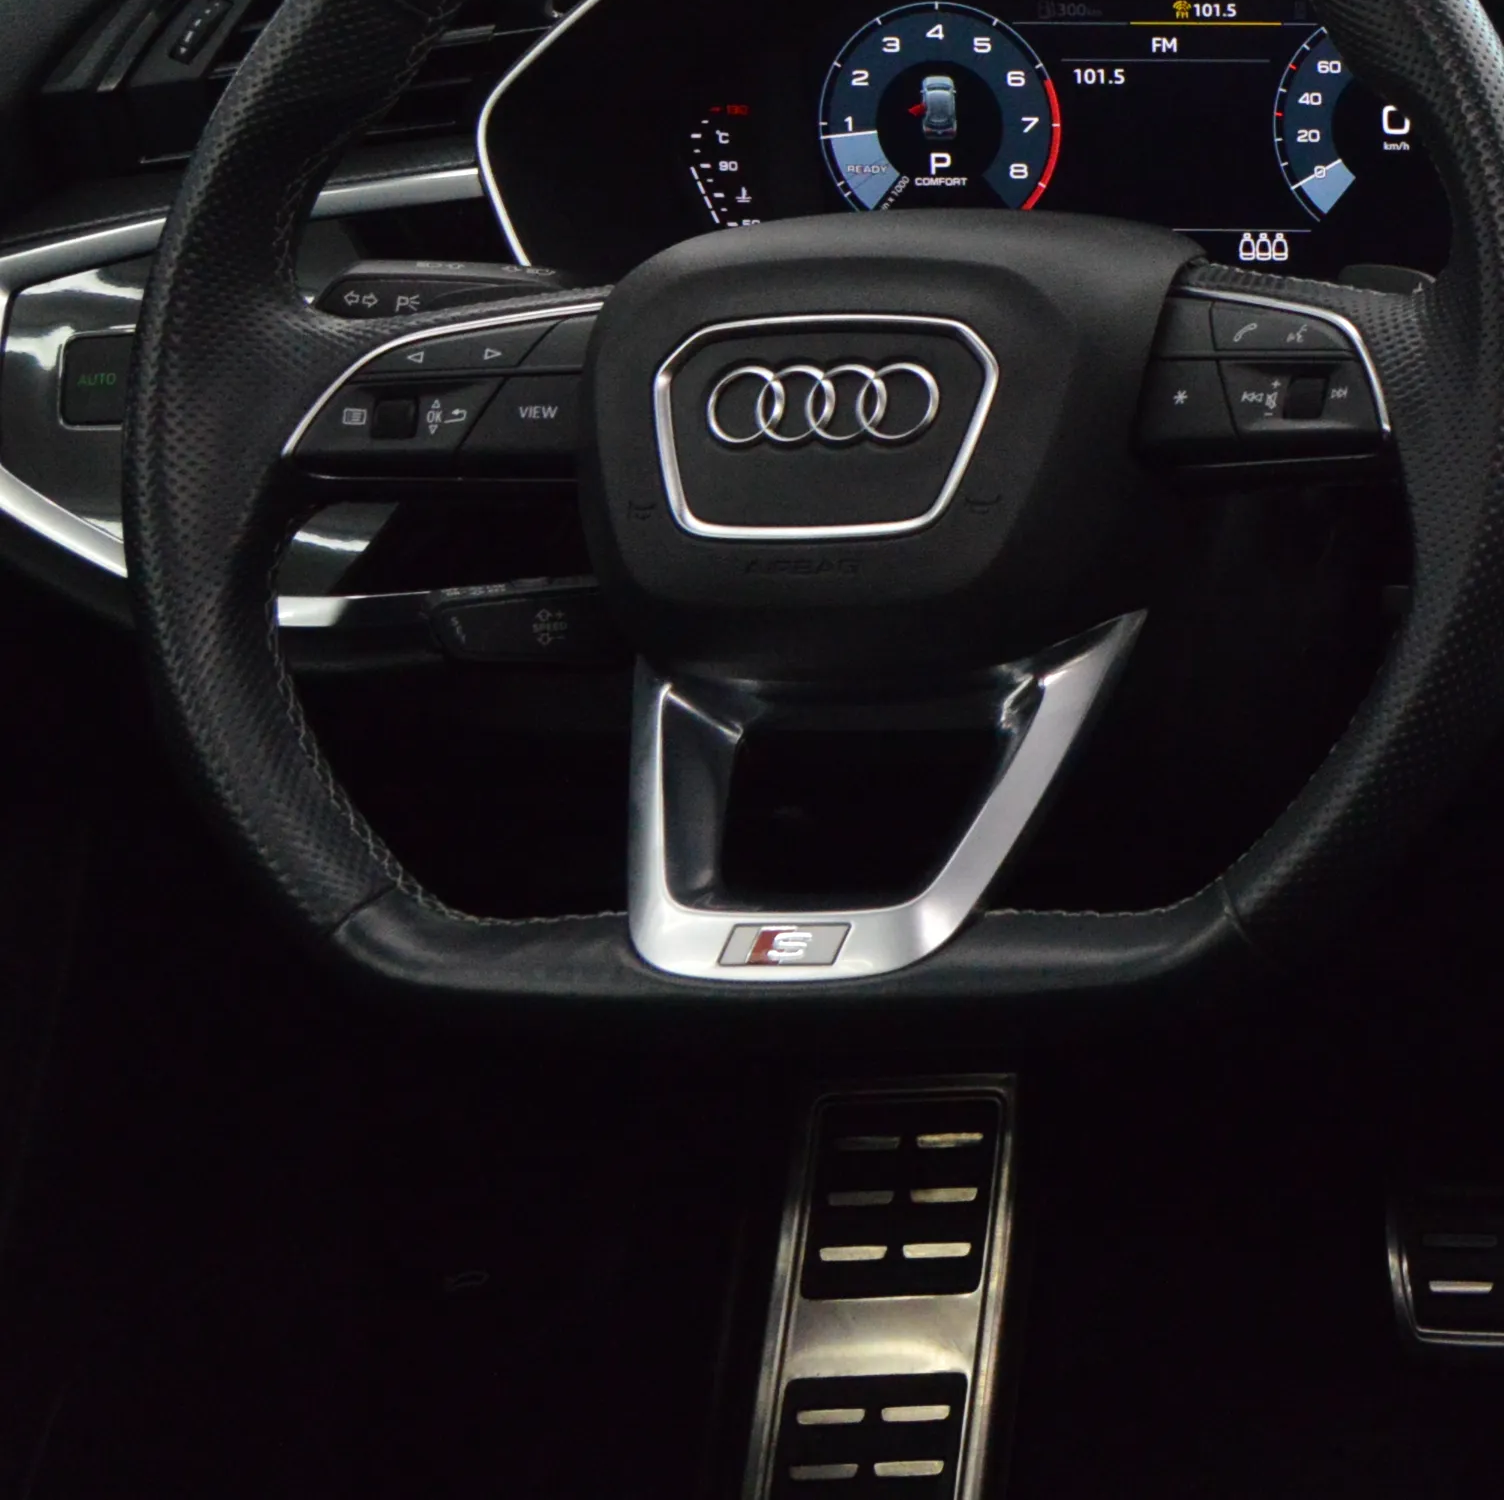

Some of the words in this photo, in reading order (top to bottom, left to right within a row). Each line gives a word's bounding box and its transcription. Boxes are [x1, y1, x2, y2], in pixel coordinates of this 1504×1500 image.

[1193, 3, 1237, 18] 101.5
[925, 24, 944, 40] 4
[882, 37, 901, 53] 3
[973, 37, 992, 53] 5
[1151, 37, 1178, 53] FM
[1317, 60, 1342, 74] 60
[851, 70, 869, 86] 2
[1006, 70, 1026, 87] 6
[1073, 68, 1126, 85] 101.5
[1298, 92, 1322, 106] 40
[844, 115, 854, 132] 1
[1021, 117, 1039, 133] 7
[1296, 129, 1321, 143] 20
[1383, 141, 1410, 151] km/h
[719, 161, 738, 172] 90
[847, 165, 887, 174] READY
[930, 152, 951, 175] P
[1009, 163, 1028, 179] 8
[1314, 165, 1326, 178] 0
[891, 175, 910, 197] 1000
[915, 177, 968, 187] COMFORT
[77, 372, 117, 386] AUTO
[426, 410, 443, 423] OK
[519, 405, 558, 419] VIEW
